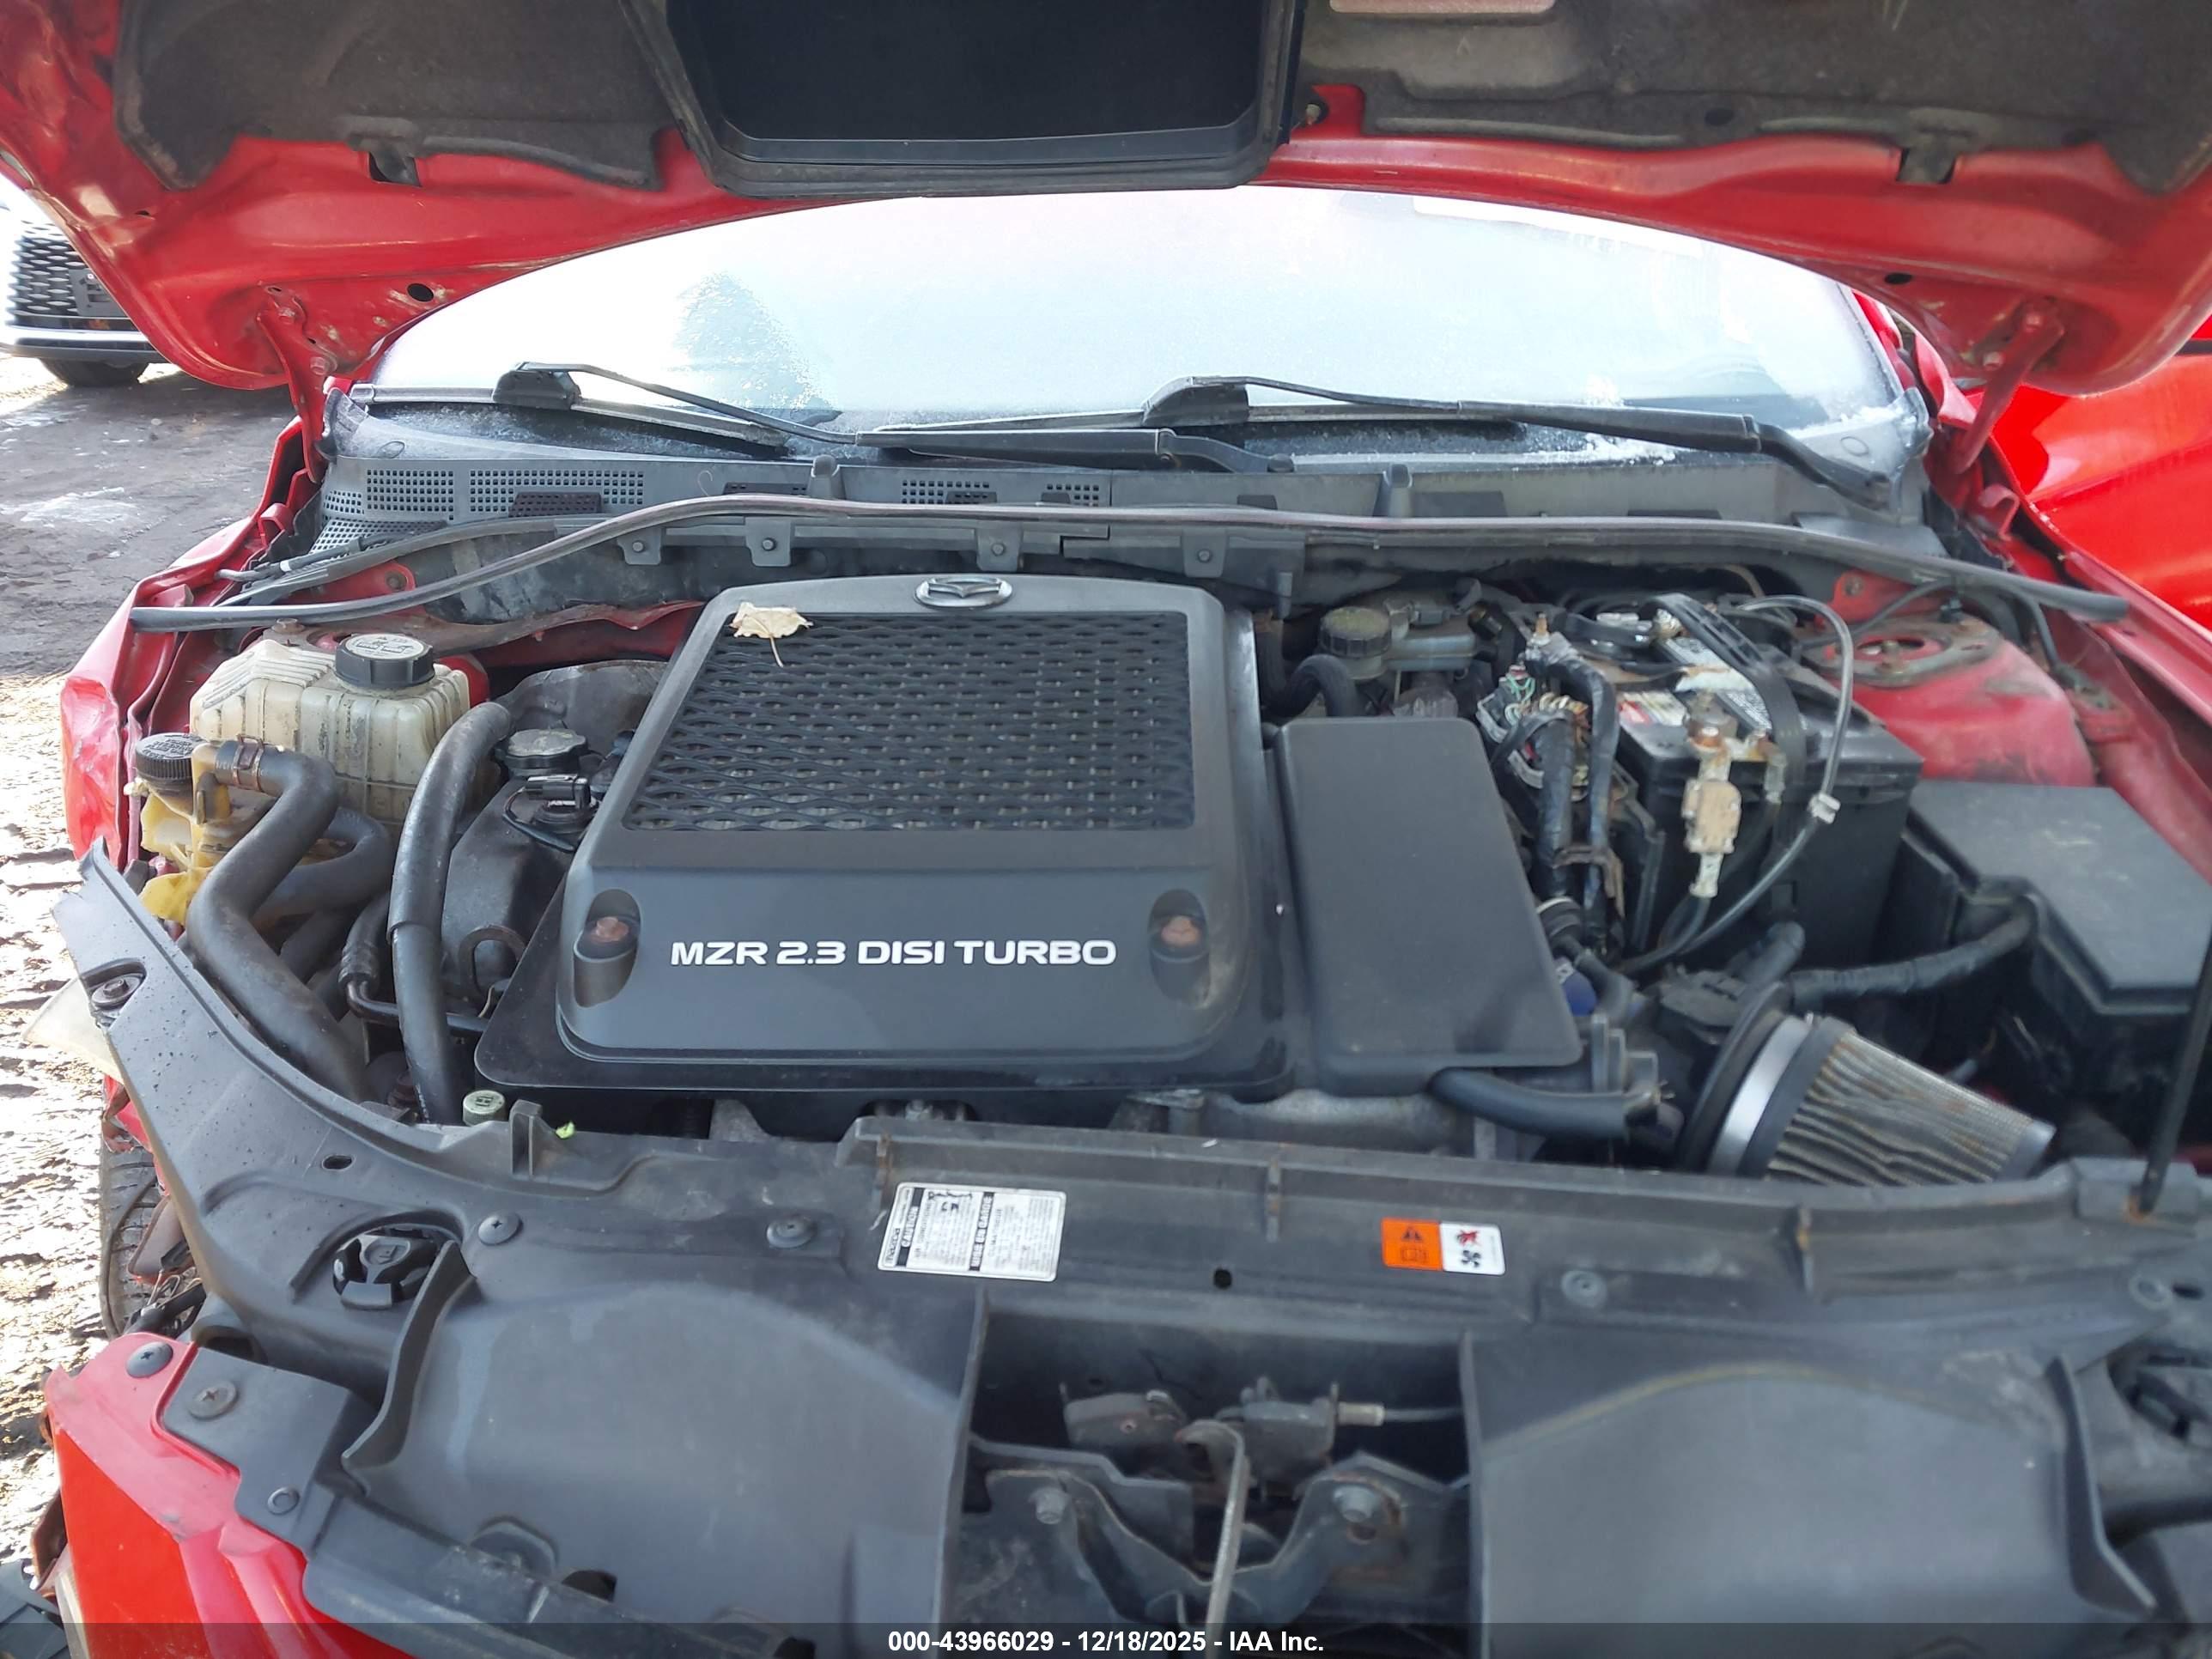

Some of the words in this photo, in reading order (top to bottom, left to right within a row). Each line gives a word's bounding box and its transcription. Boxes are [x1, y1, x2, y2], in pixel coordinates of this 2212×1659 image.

[671, 941, 769, 965] MZR
[776, 940, 847, 965] 2.3
[858, 940, 945, 965] DISI
[953, 939, 1117, 965] TURBO
[901, 1206, 920, 1248] CAUTION
